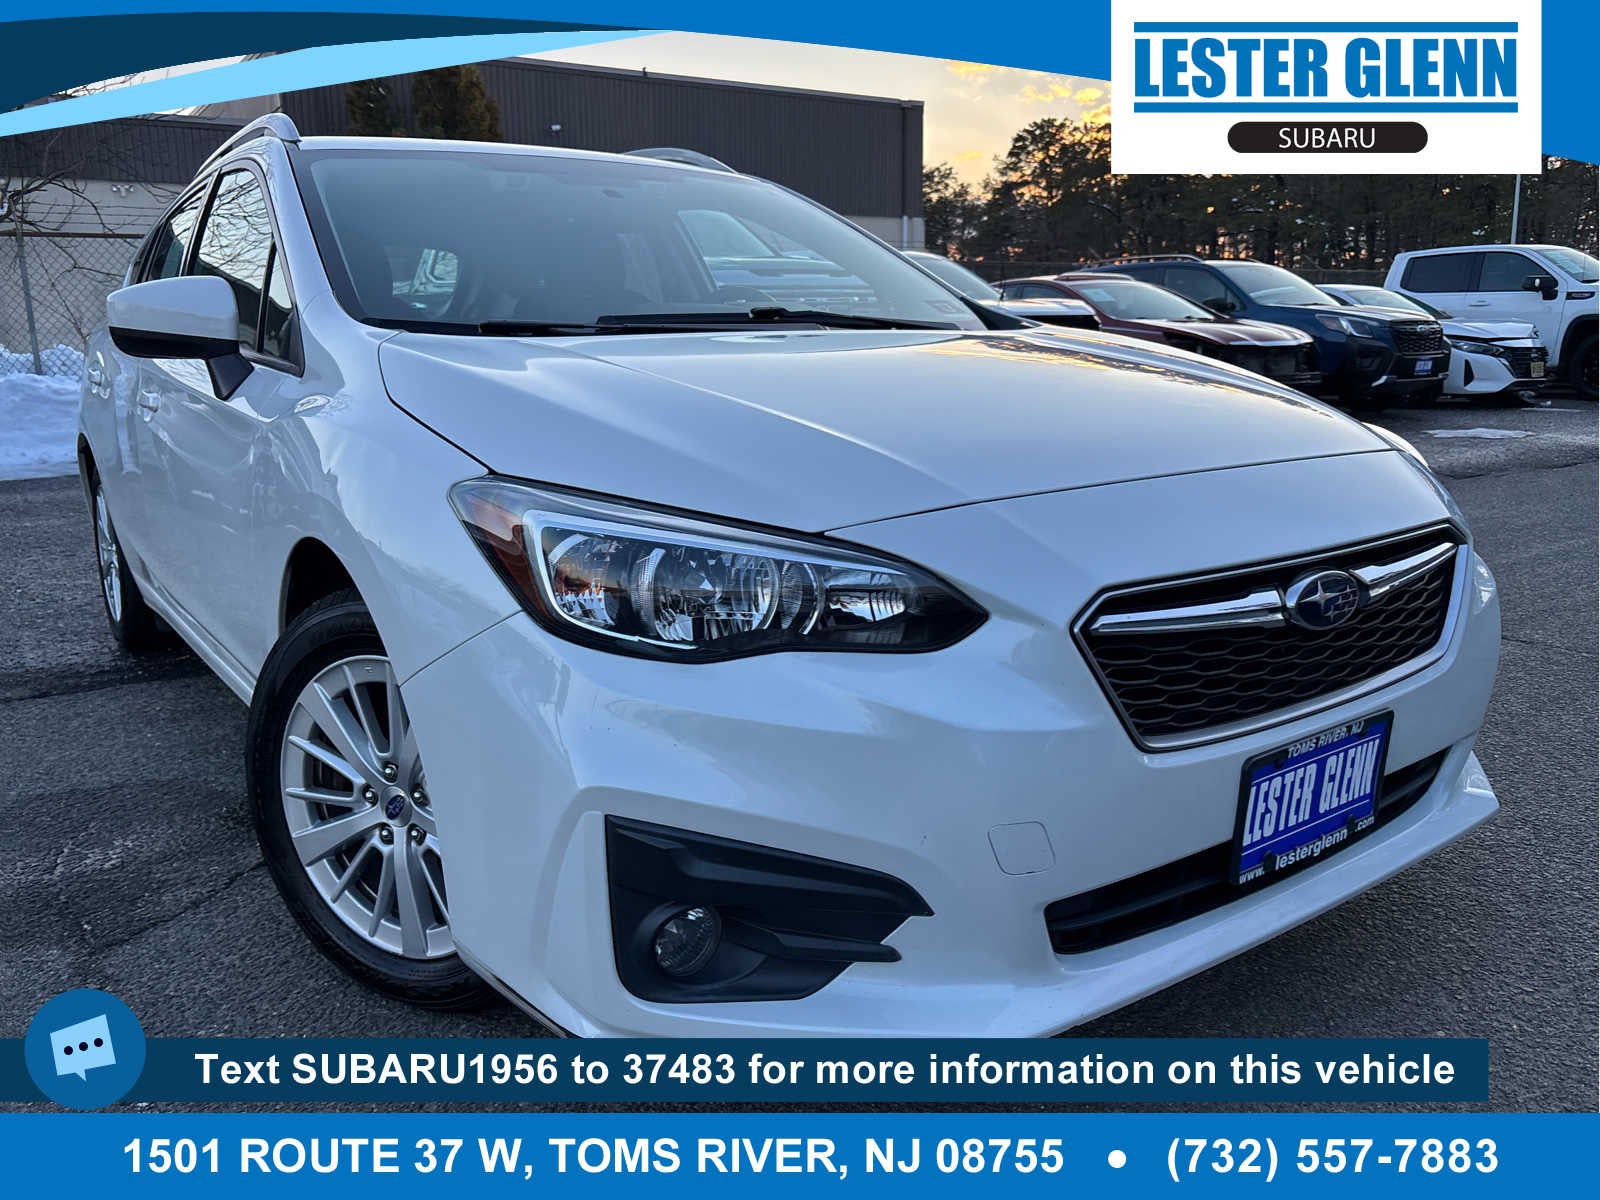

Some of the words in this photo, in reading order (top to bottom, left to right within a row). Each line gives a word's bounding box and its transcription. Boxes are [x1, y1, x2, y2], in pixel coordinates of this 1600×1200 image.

[1287, 739, 1316, 759] TOMS
[1242, 762, 1317, 847] LESTER
[1319, 738, 1380, 814] GLENN
[1275, 829, 1348, 870] lesterglenn
